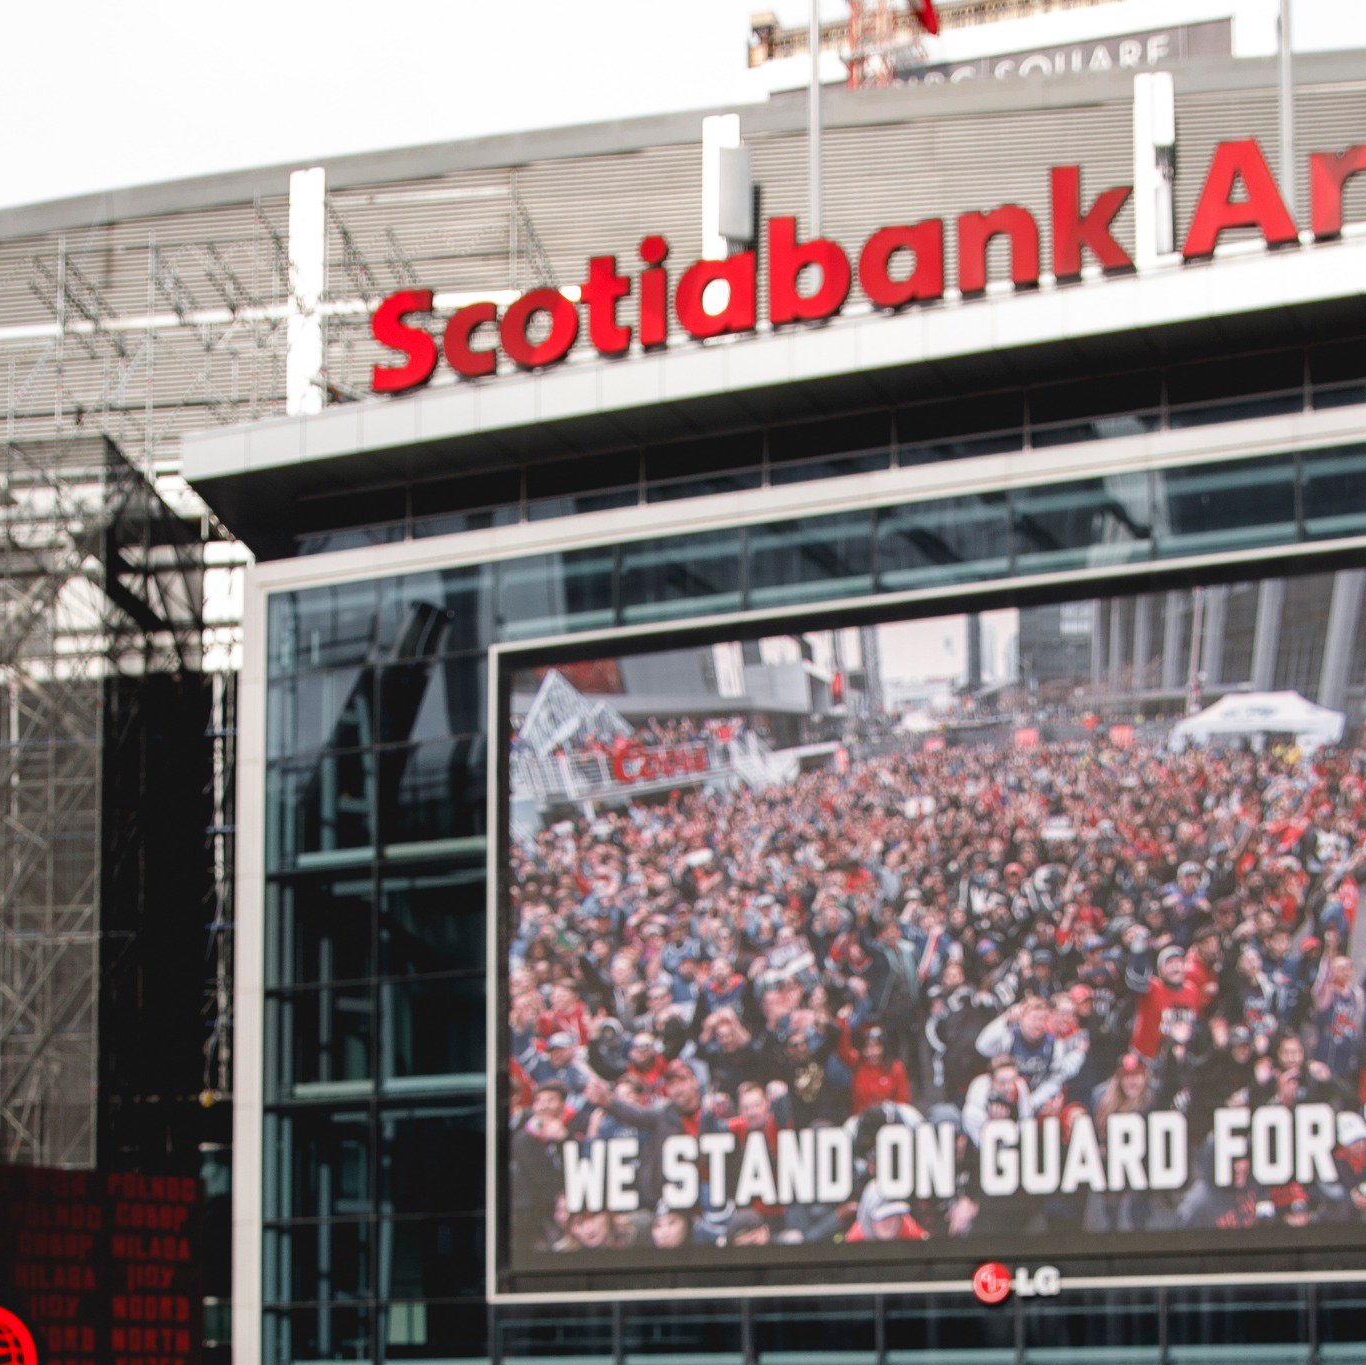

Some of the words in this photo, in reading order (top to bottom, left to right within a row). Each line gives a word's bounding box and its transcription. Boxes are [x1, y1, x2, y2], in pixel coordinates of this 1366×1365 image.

[370, 164, 1135, 393] Scotiabank
[564, 1137, 640, 1214] WE
[660, 1125, 855, 1212] STAND
[871, 1120, 957, 1201] ON
[977, 1108, 1189, 1197] GUARD
[1211, 1102, 1337, 1187] FOR
[1016, 1266, 1061, 1297] LG
